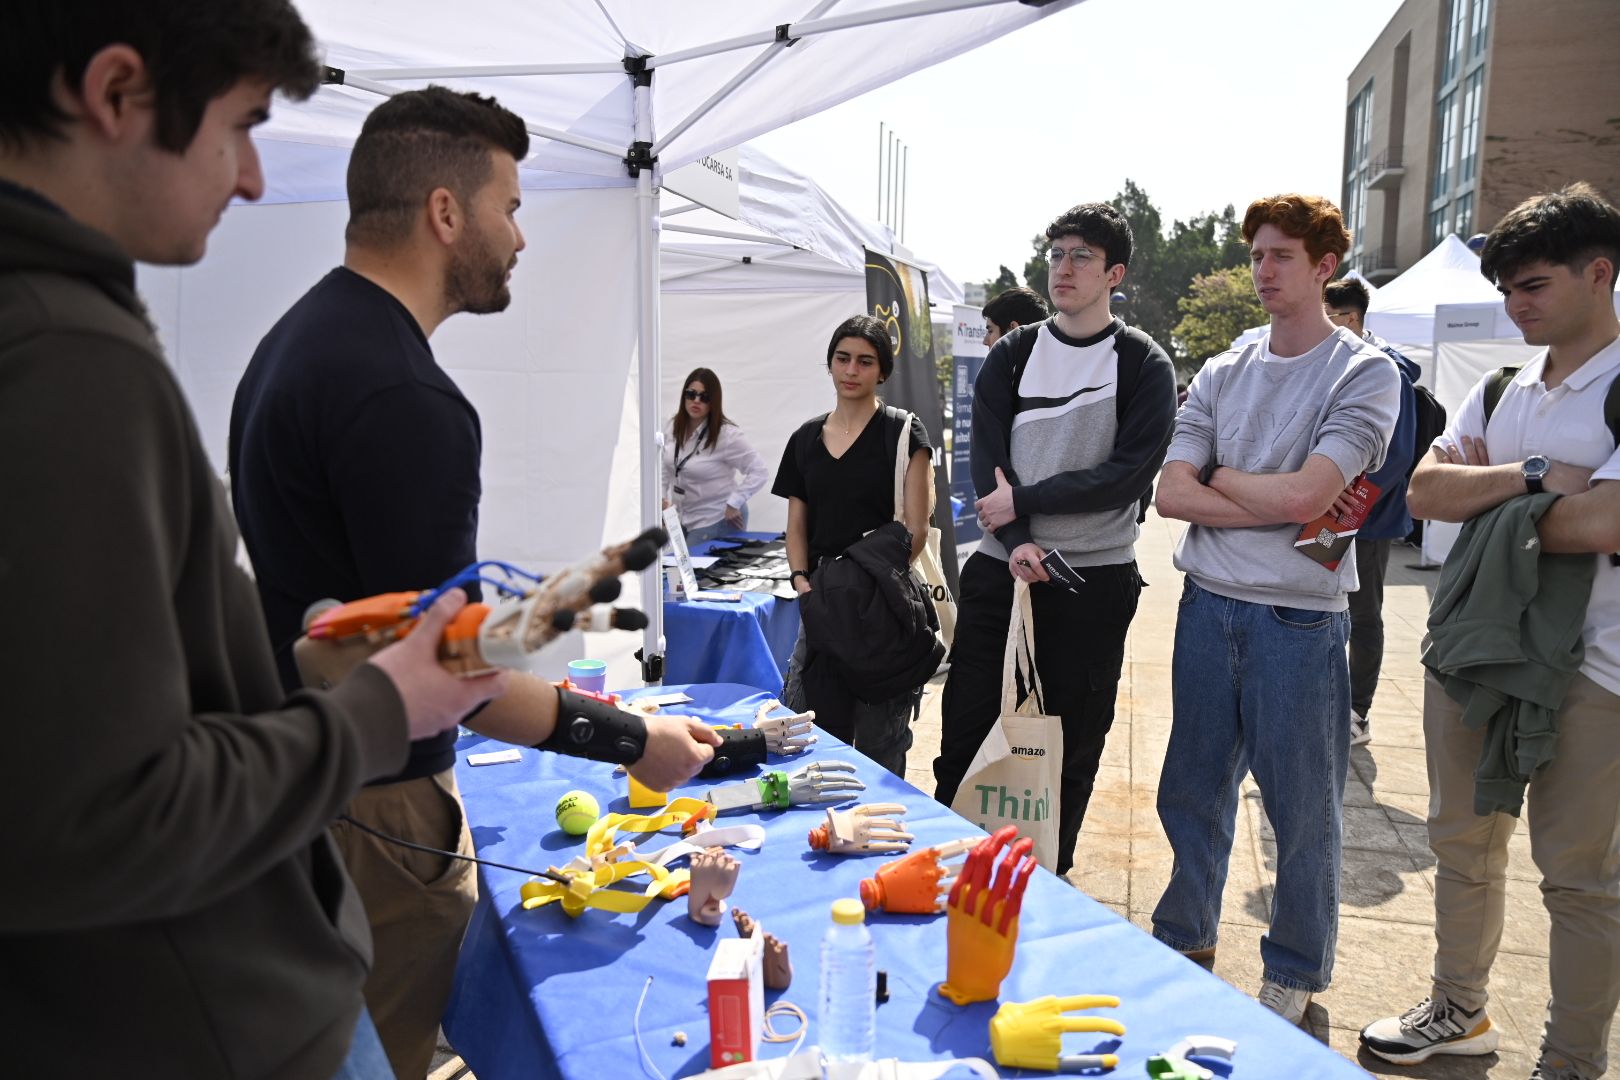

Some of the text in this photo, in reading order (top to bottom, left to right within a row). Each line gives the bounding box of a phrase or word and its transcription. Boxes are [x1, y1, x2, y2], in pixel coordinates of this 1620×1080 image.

[726, 166, 733, 181] SA
[1046, 562, 1070, 583] amazon
[1011, 746, 1046, 757] amazo
